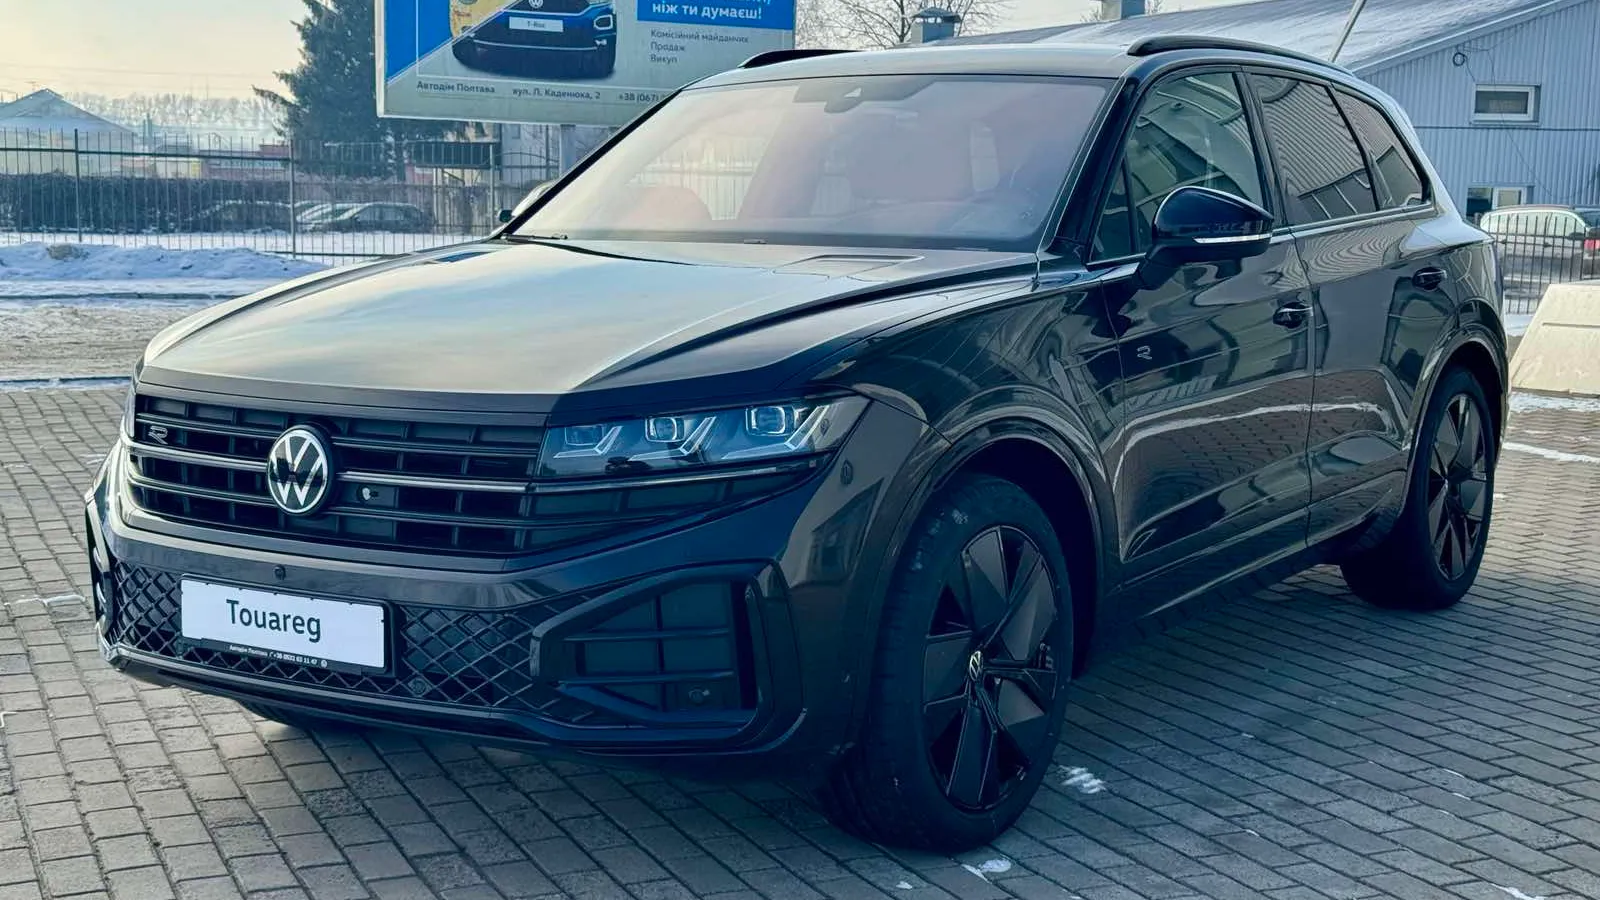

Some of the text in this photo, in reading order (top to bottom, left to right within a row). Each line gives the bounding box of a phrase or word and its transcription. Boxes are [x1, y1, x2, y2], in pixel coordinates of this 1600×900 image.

[652, 1, 762, 19] ніж ти думаєш!
[650, 29, 749, 43] Комісійний майданчик
[650, 41, 685, 52] Продаж
[650, 53, 677, 64] Викуп
[416, 81, 455, 93] Автодім
[457, 83, 496, 94] Полтава
[512, 88, 532, 97] вул.
[544, 88, 593, 99] Каденюка,
[595, 91, 601, 99] 2
[619, 92, 635, 101] +38
[226, 599, 321, 643] Touareg
